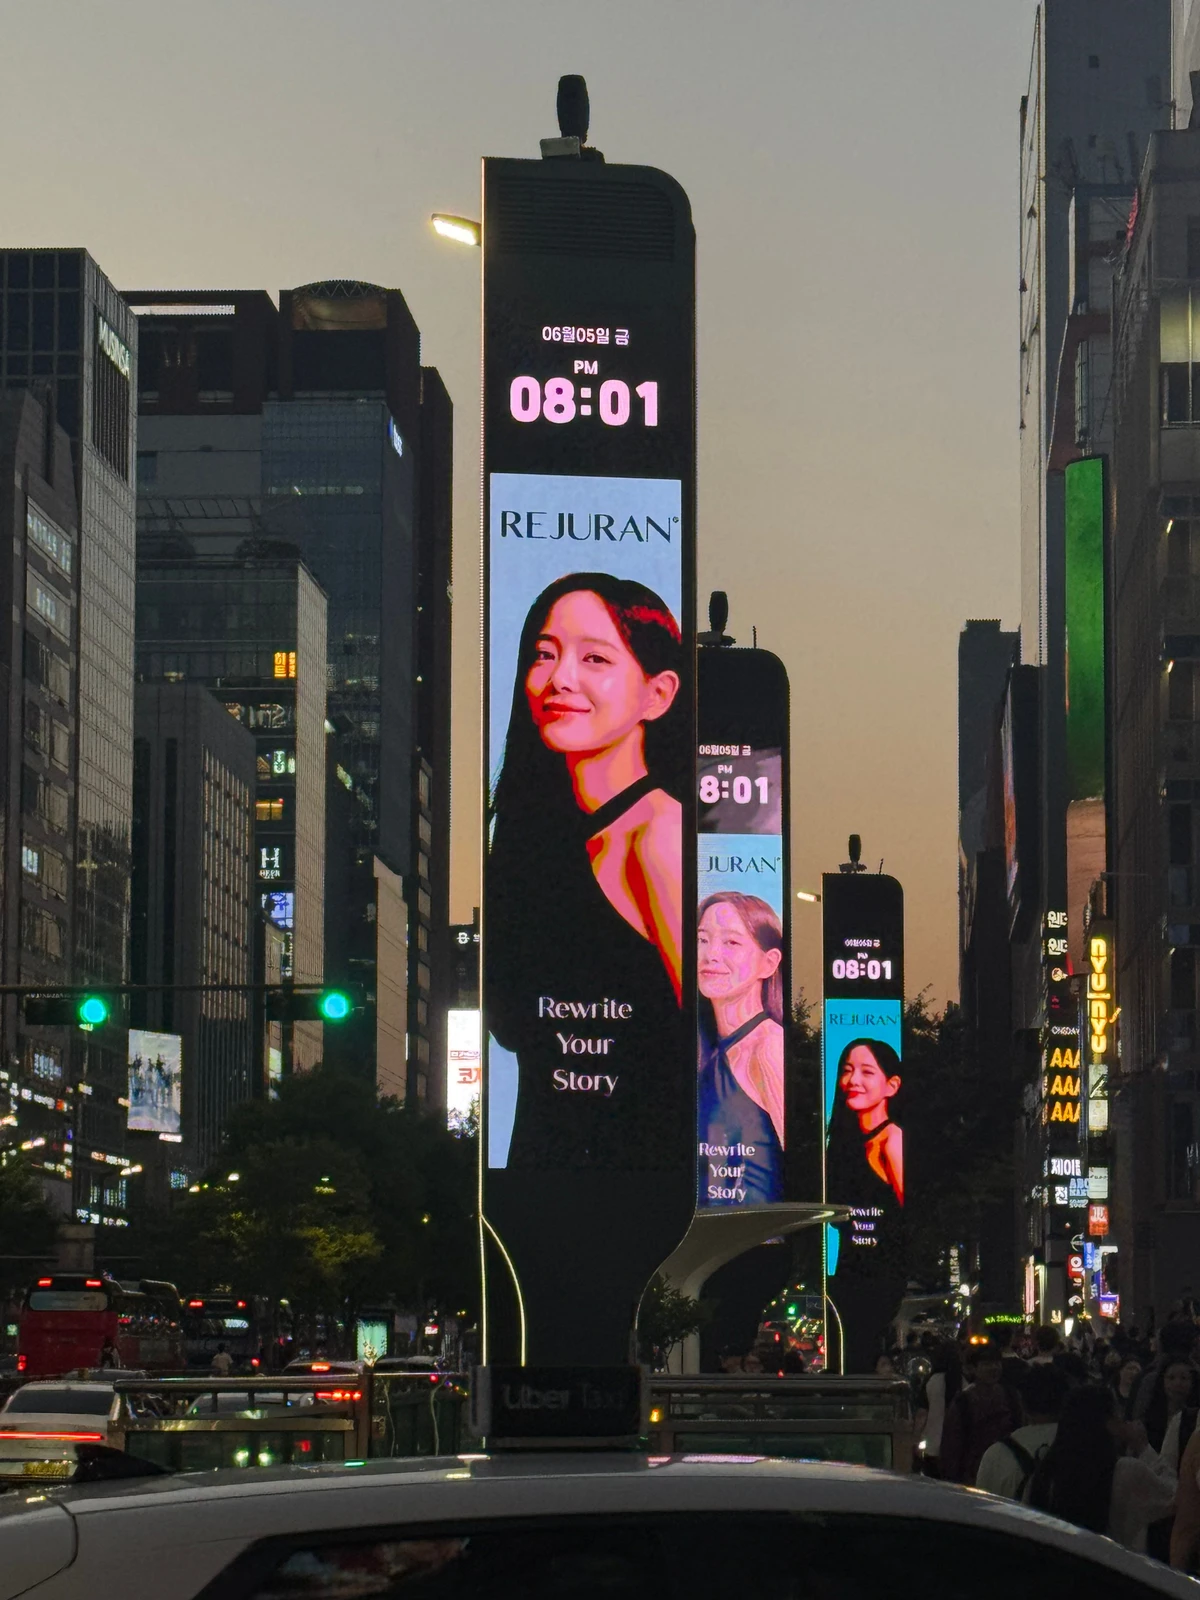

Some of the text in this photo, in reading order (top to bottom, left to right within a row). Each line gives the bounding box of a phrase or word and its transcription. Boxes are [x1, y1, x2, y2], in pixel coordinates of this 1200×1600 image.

[542, 326, 629, 346] 06월05일 금
[573, 360, 599, 375] PM
[510, 375, 658, 427] 08:01
[717, 764, 733, 774] PM
[699, 775, 769, 804] 8:01
[699, 855, 777, 873] JURAN
[832, 959, 892, 980] 08:01
[538, 996, 633, 1020] Rewrite
[556, 1032, 615, 1055] Your
[552, 1069, 619, 1097] Story
[699, 1142, 756, 1157] Rewrite
[709, 1163, 746, 1178] Your
[707, 1184, 748, 1203] Story
